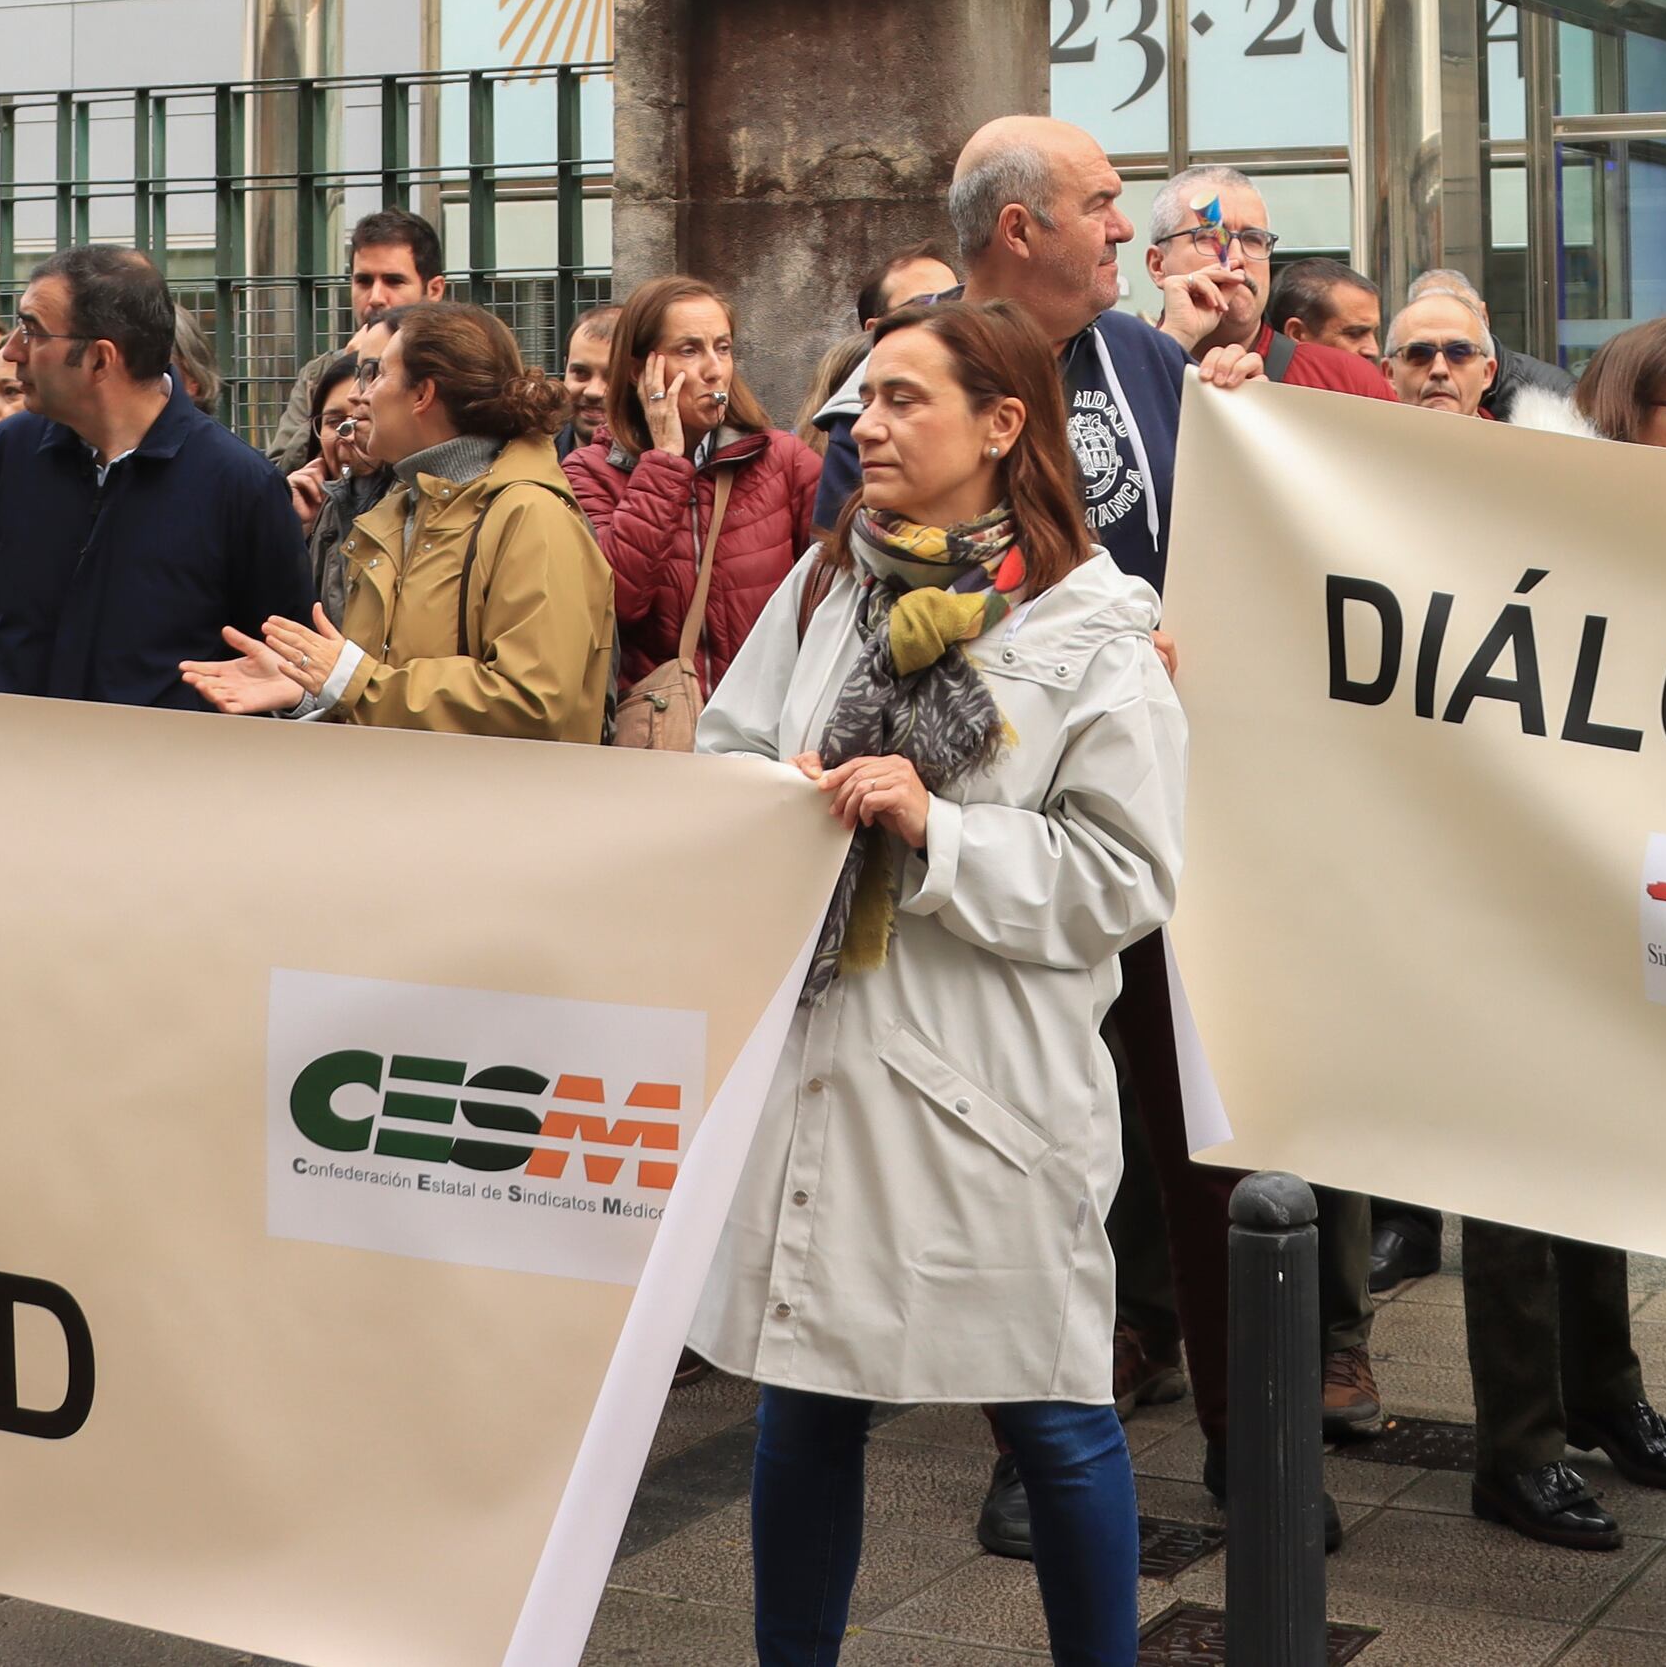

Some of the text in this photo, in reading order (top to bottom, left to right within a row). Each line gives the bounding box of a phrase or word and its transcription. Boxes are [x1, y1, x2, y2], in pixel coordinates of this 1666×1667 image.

[290, 1048, 682, 1191] CESM
[292, 1156, 412, 1191] Confederación
[417, 1173, 477, 1200] Estatal
[481, 1182, 503, 1202] de
[507, 1184, 597, 1214] Sindicatos
